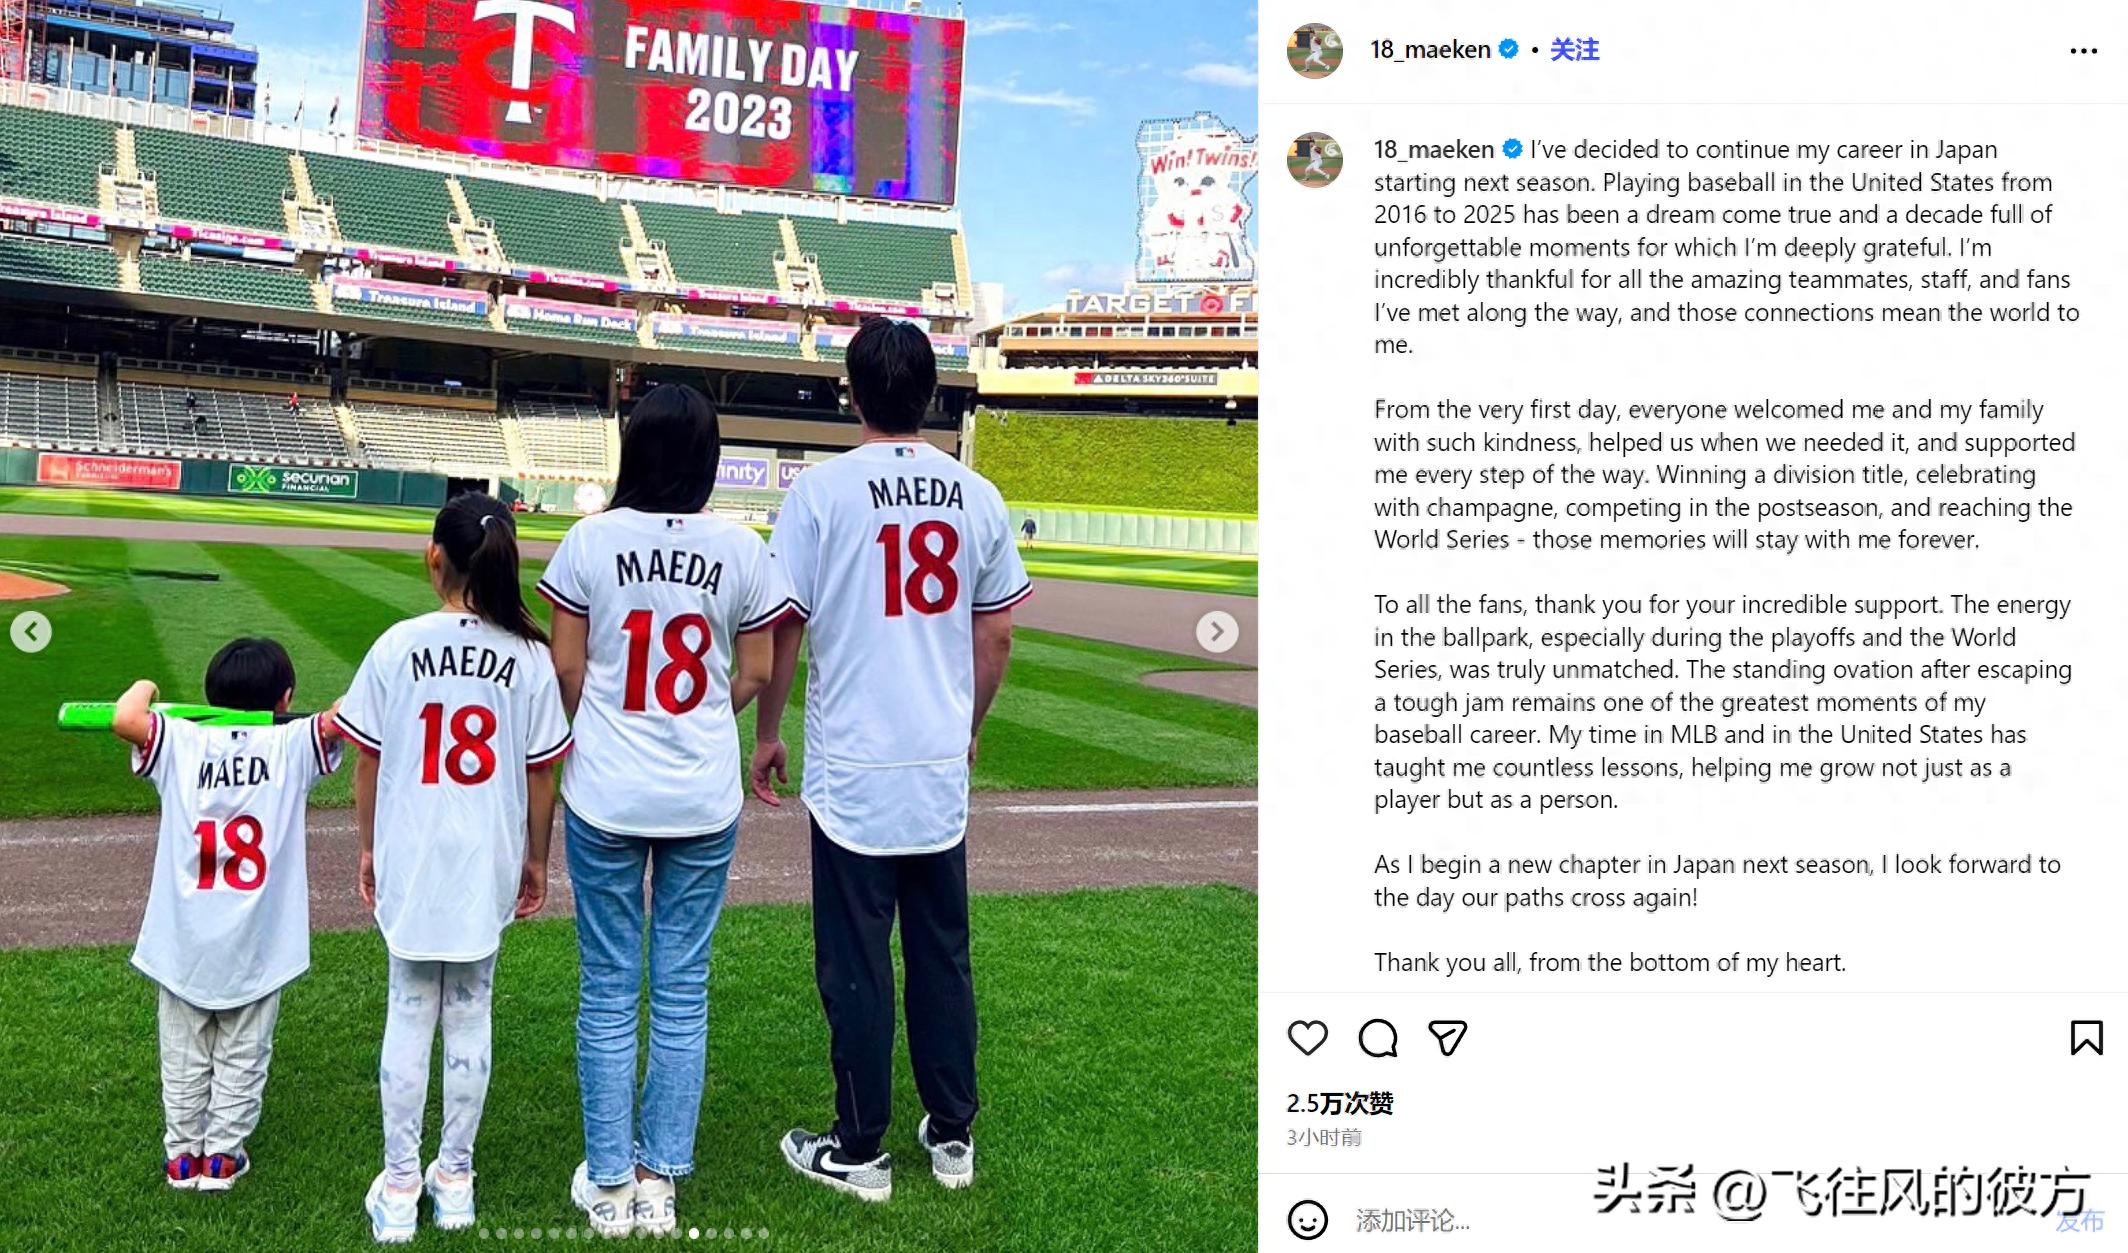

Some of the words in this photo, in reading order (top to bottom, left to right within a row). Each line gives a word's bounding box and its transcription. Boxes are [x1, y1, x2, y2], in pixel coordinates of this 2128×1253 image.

[624, 25, 773, 83] FAMILY
[781, 43, 860, 93] DAY
[684, 88, 793, 141] 2023
[1151, 149, 1193, 174] Win!
[1196, 144, 1257, 168] Twins!
[1066, 291, 1196, 313] TARGET
[282, 471, 350, 485] securian
[282, 483, 330, 493] FINANCIAL
[868, 477, 964, 511] MAEDA
[616, 549, 723, 596] MAEDA
[875, 519, 960, 618] 18
[412, 645, 517, 688] MAEDA
[621, 609, 713, 716] 18
[419, 702, 497, 785] 18
[193, 814, 267, 891] 18
